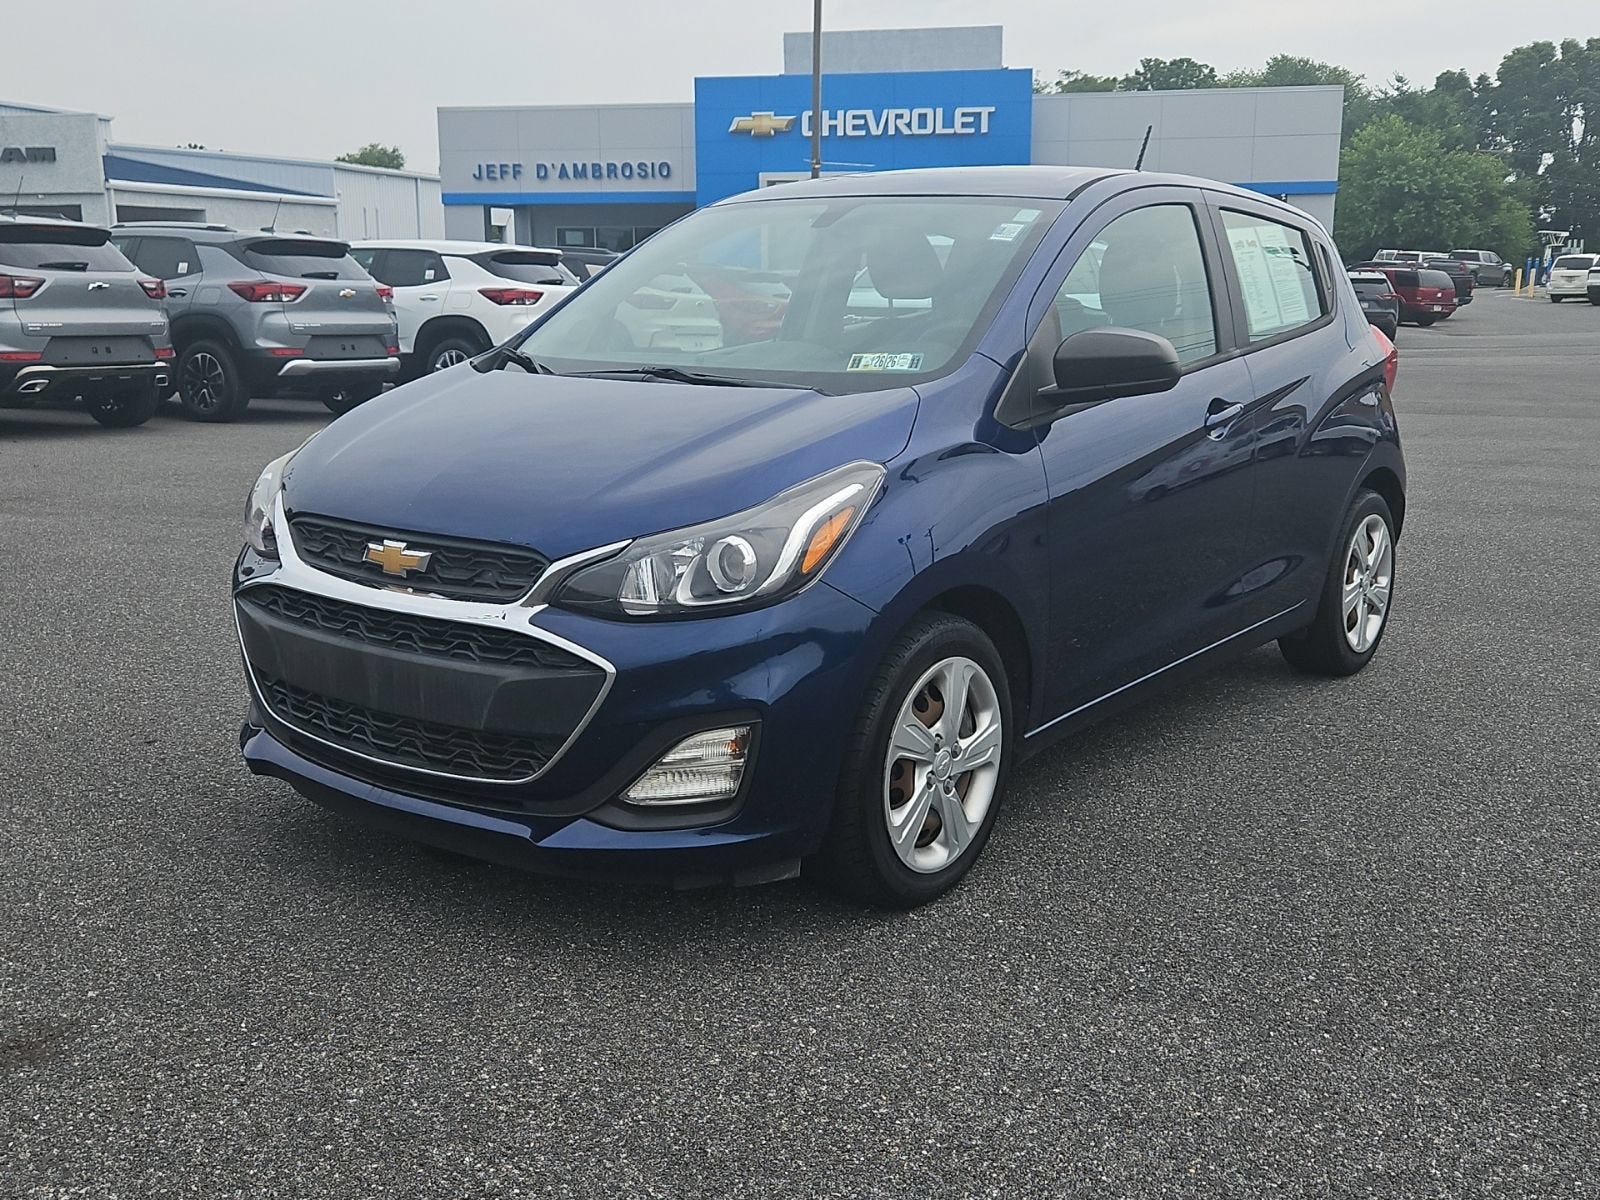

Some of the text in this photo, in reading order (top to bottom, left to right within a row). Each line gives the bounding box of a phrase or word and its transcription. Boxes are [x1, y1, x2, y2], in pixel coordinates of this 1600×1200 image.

[801, 106, 996, 137] CHEVROLET
[472, 161, 672, 181] JEFF D'AMBROSIO
[873, 355, 885, 368] 26
[886, 355, 898, 368] 26
